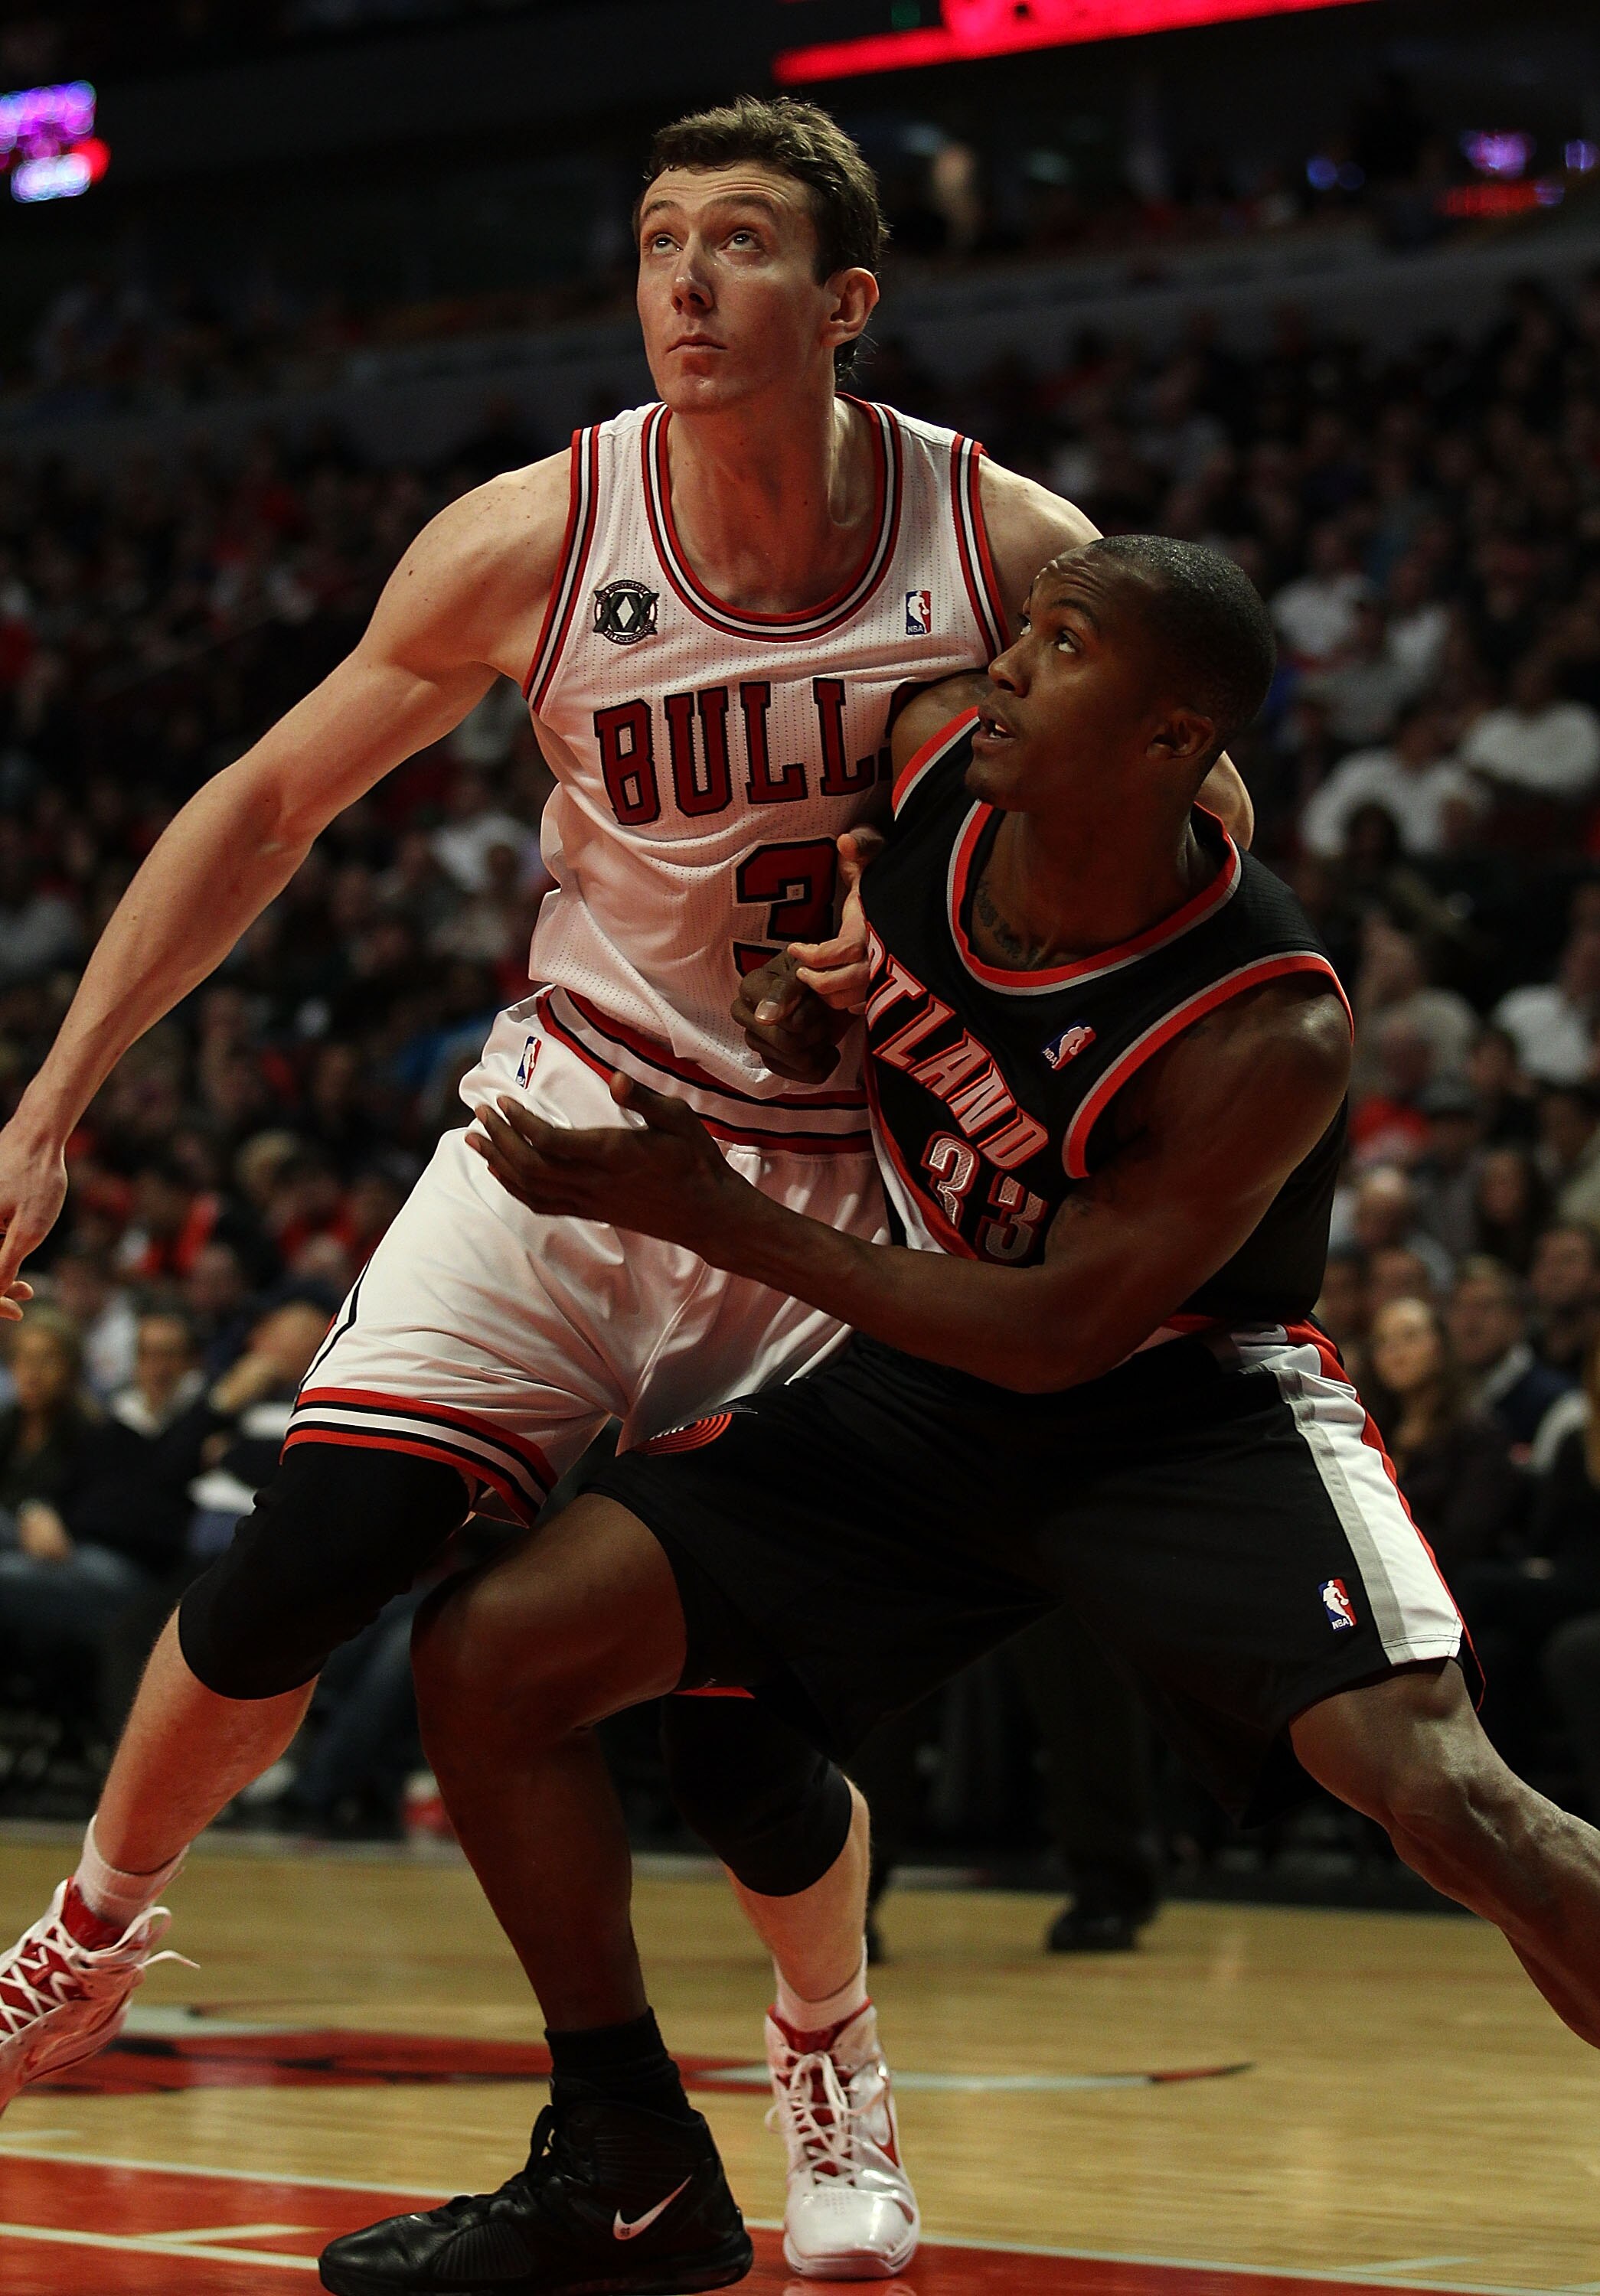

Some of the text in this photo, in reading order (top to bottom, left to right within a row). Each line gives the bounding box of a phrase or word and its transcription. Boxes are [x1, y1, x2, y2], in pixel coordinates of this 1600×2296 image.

[907, 625, 924, 633] NBA
[594, 677, 926, 825] BULL
[1042, 1048, 1058, 1065] NBA
[1331, 1617, 1350, 1629] NBA
